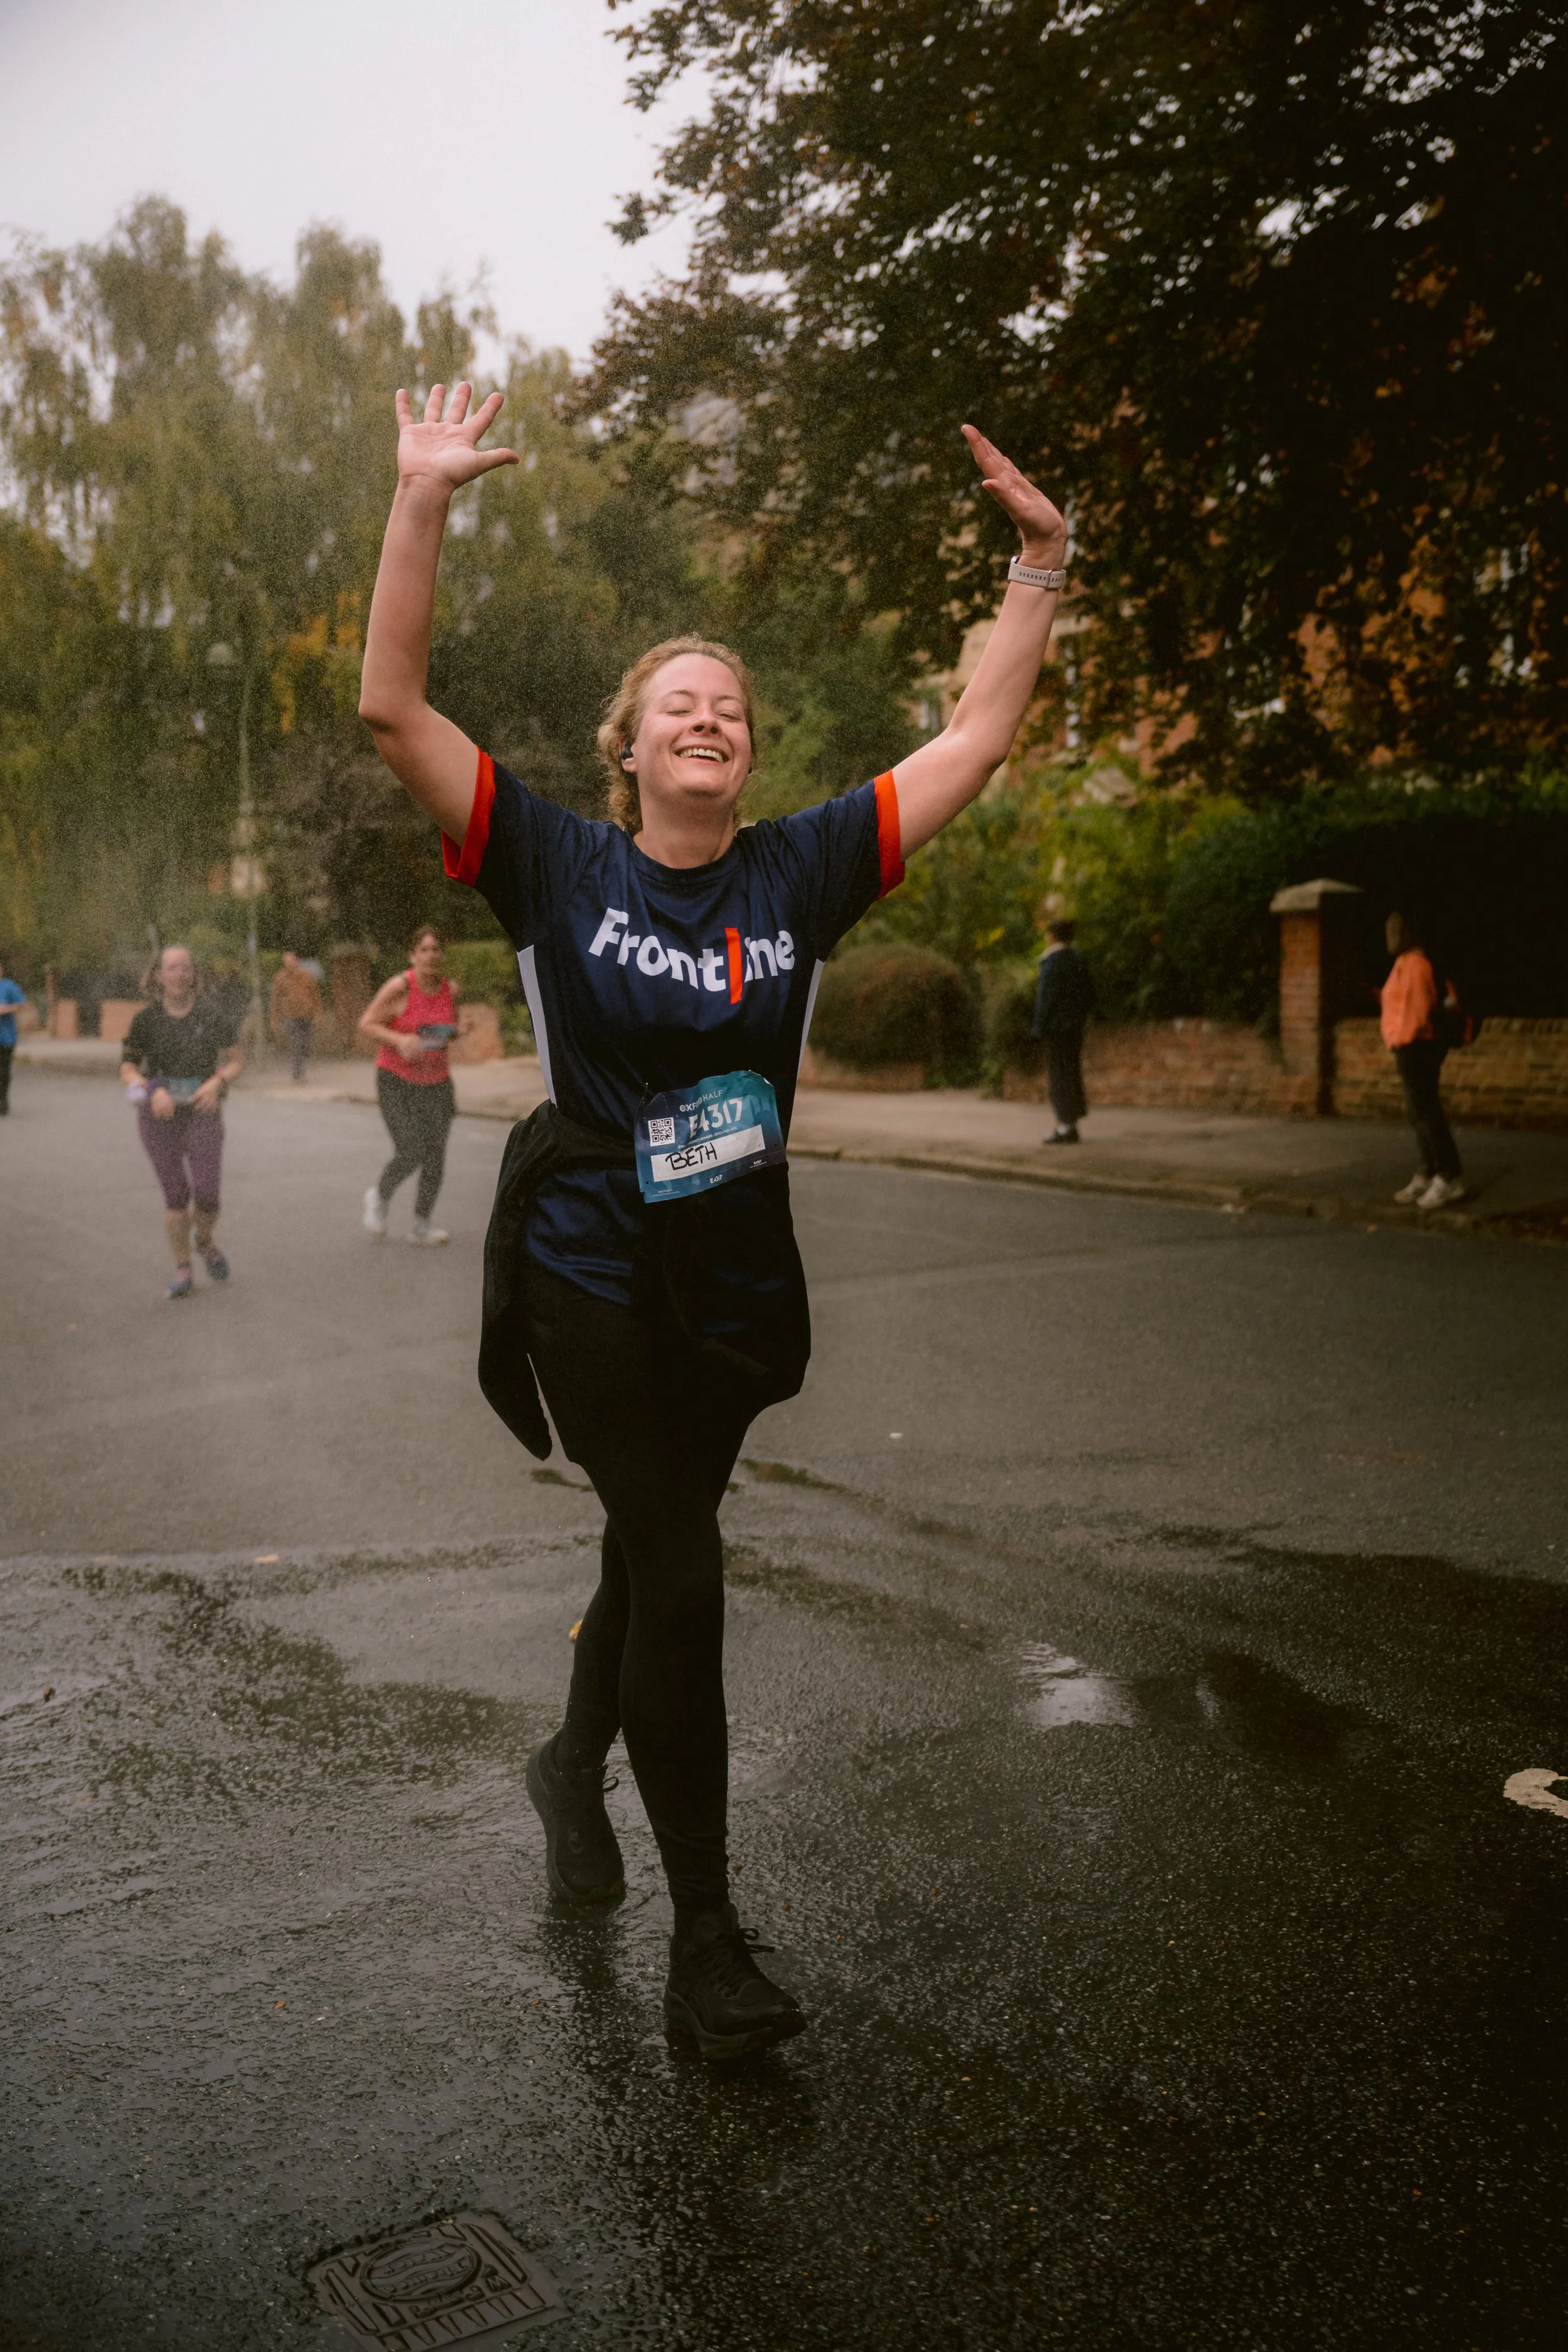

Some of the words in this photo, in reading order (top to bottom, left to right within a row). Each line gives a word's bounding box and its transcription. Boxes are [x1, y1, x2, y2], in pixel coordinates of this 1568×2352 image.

[588, 907, 795, 1005] Frontline
[702, 1089, 723, 1102] HALF
[689, 1096, 743, 1139] E4317
[665, 1142, 718, 1171] BETH
